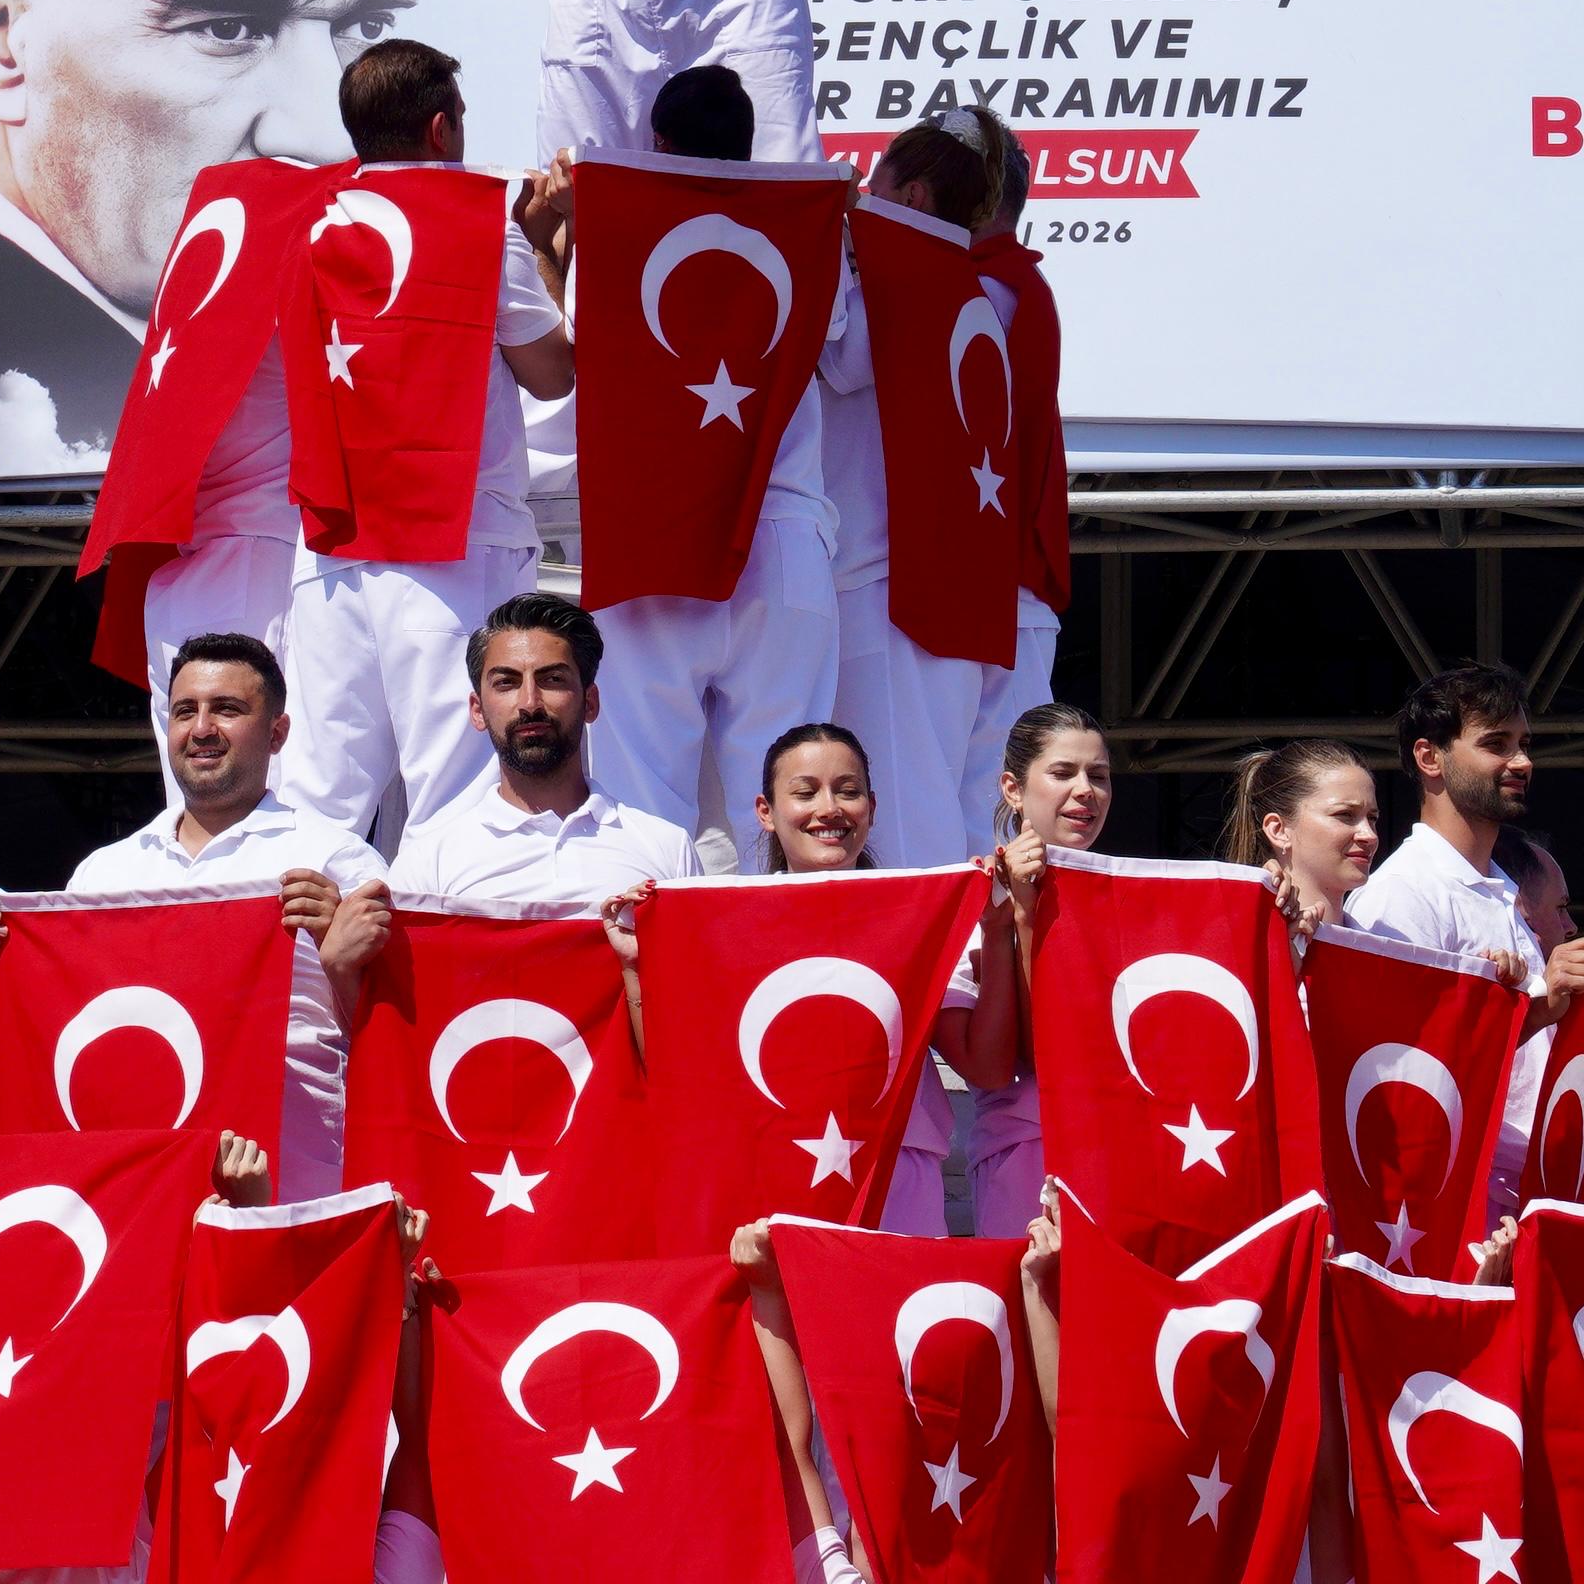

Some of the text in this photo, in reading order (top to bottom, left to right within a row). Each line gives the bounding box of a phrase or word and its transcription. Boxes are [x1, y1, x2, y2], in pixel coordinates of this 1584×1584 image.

[1111, 19, 1195, 60] VE
[876, 77, 1309, 120] BAYRAMIMIZ
[1033, 148, 1176, 186] LSUN
[1046, 221, 1133, 244] 2026
